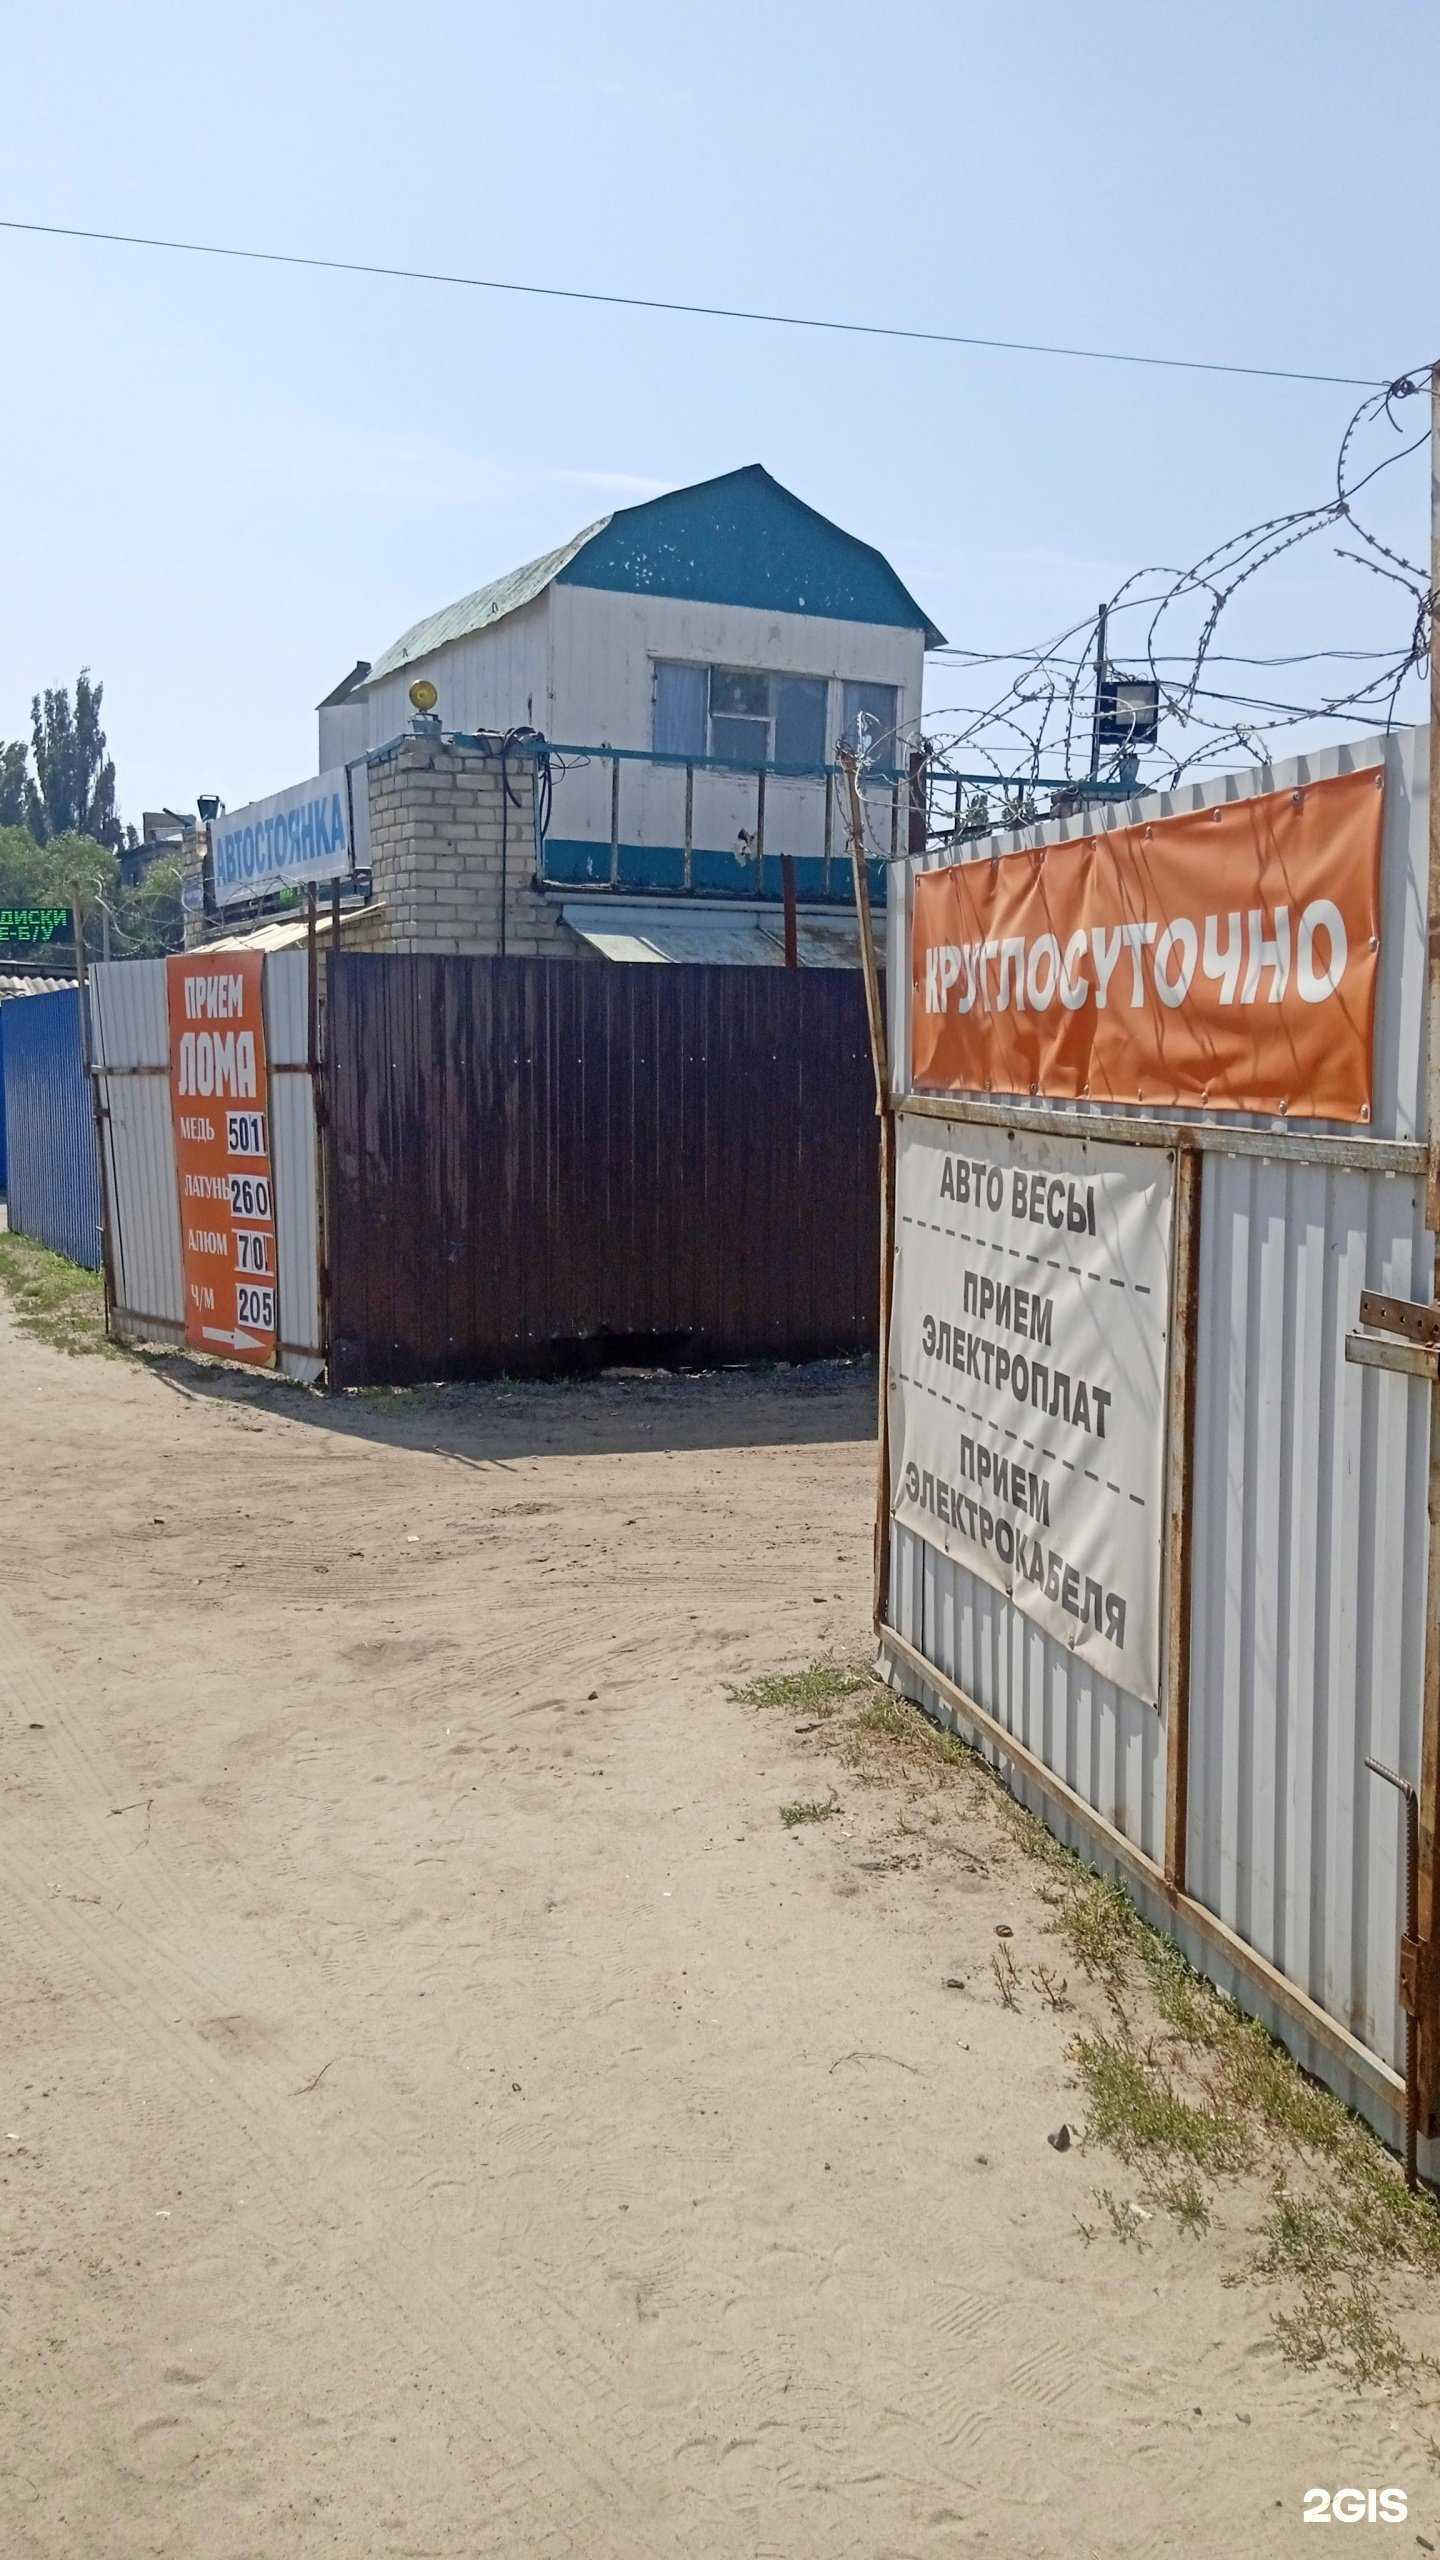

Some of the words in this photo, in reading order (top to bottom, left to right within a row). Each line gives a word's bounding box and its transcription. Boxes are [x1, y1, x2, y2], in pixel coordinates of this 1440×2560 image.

[215, 792, 347, 888] АВТОСТОЯНКА
[0, 909, 68, 926] ДИСКИ
[924, 899, 1349, 1015] КРУГЛОСУТОЧНО
[184, 974, 244, 1020] ПРИЕМ
[178, 1030, 257, 1098] ЛОМА
[180, 1116, 216, 1142] МЕДЬ
[228, 1117, 260, 1153] 501
[185, 1174, 231, 1201] ЛАТУНЬ
[230, 1179, 268, 1216] 260
[939, 1156, 1004, 1213] АВТО
[1011, 1169, 1097, 1237] ВЕСЫ
[188, 1228, 228, 1257] АЛЮМ
[191, 1284, 215, 1313] Ч/М
[238, 1287, 273, 1327] 205
[963, 1269, 1054, 1347] ПРИЕМ
[922, 1313, 1112, 1440] ЭЛЕКТРОПЛАТ
[960, 1433, 1050, 1528] ПРИЕМ
[904, 1461, 1127, 1650] ЭЛЕКТРОКАБЕЛЯ
